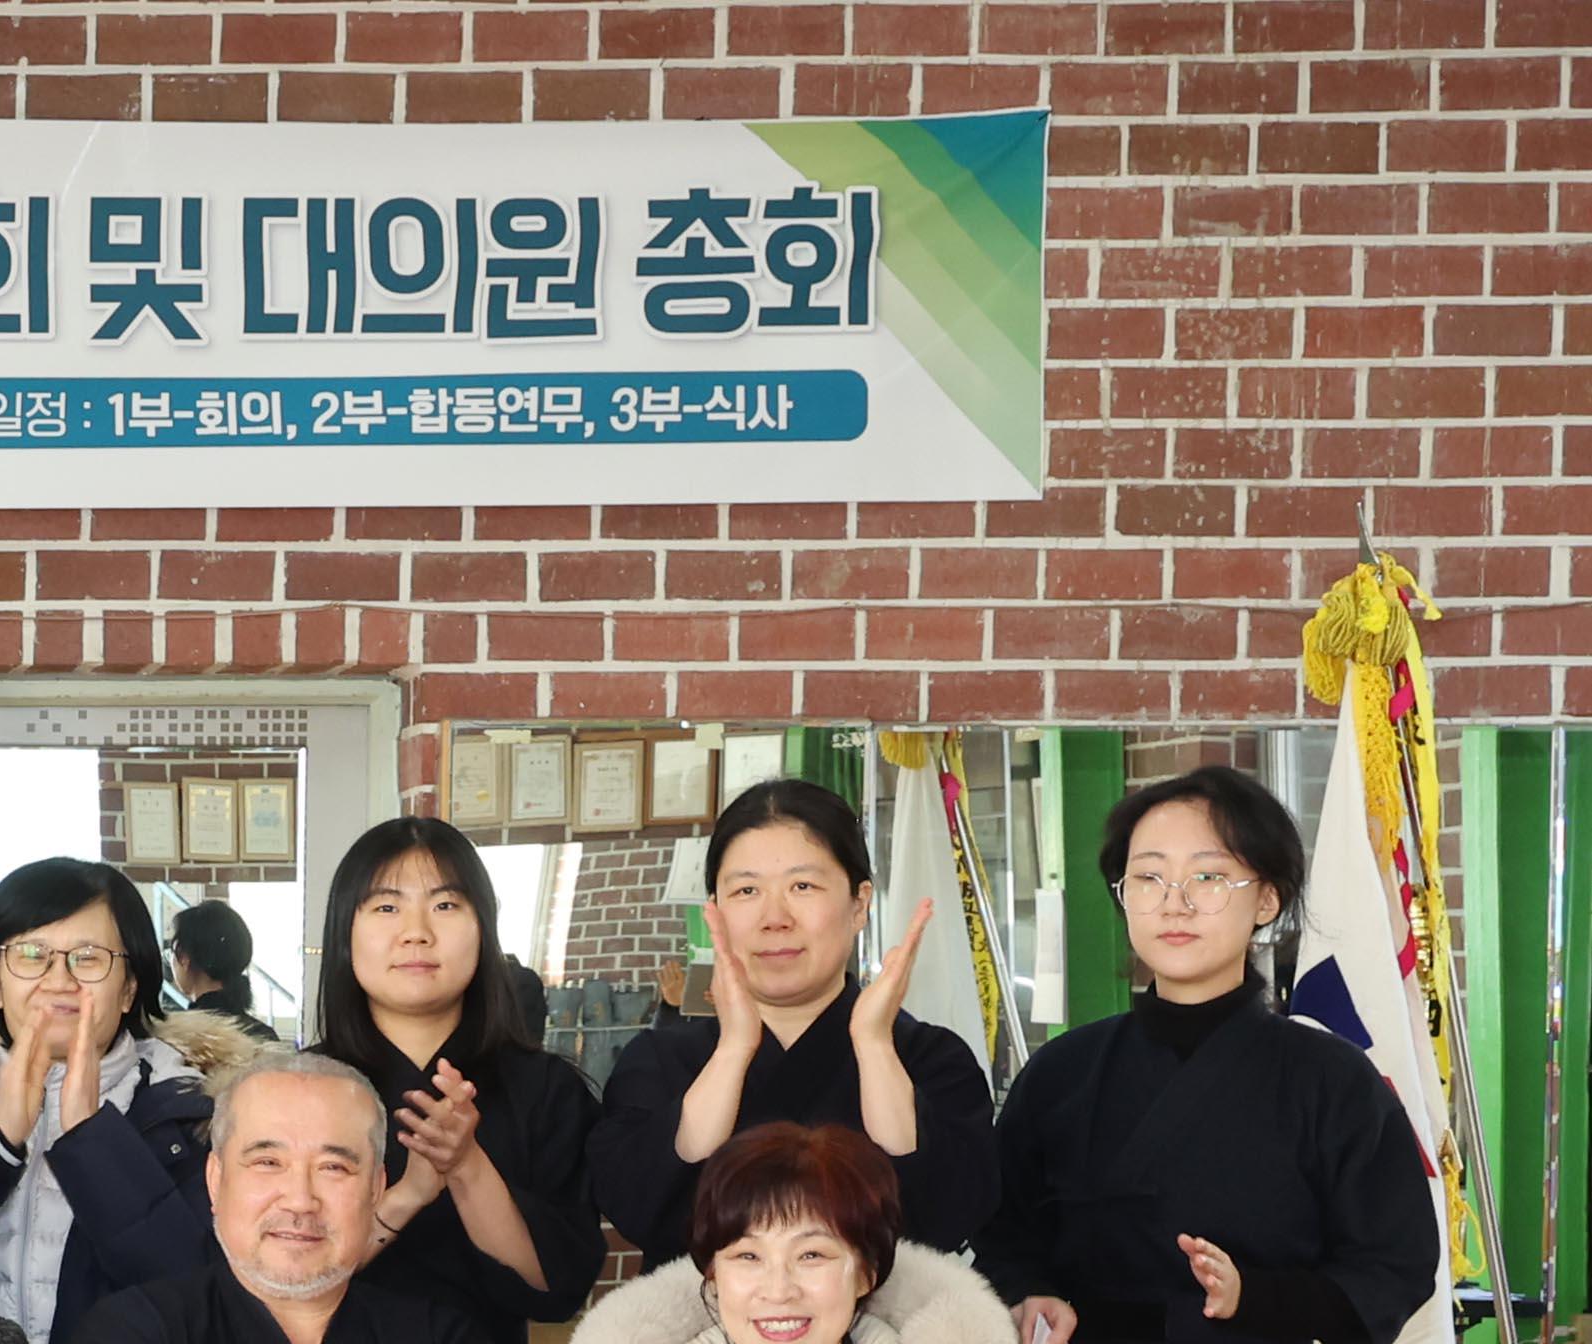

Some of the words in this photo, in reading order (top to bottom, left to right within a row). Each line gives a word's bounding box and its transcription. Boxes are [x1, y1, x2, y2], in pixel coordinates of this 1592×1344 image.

[88, 196, 205, 341] 및
[242, 196, 602, 340] 대의원
[635, 187, 877, 334] 총회
[107, 391, 297, 441] 1부-회의,
[311, 388, 595, 438] 2부-합동연무,
[610, 385, 794, 432] 3부-식사
